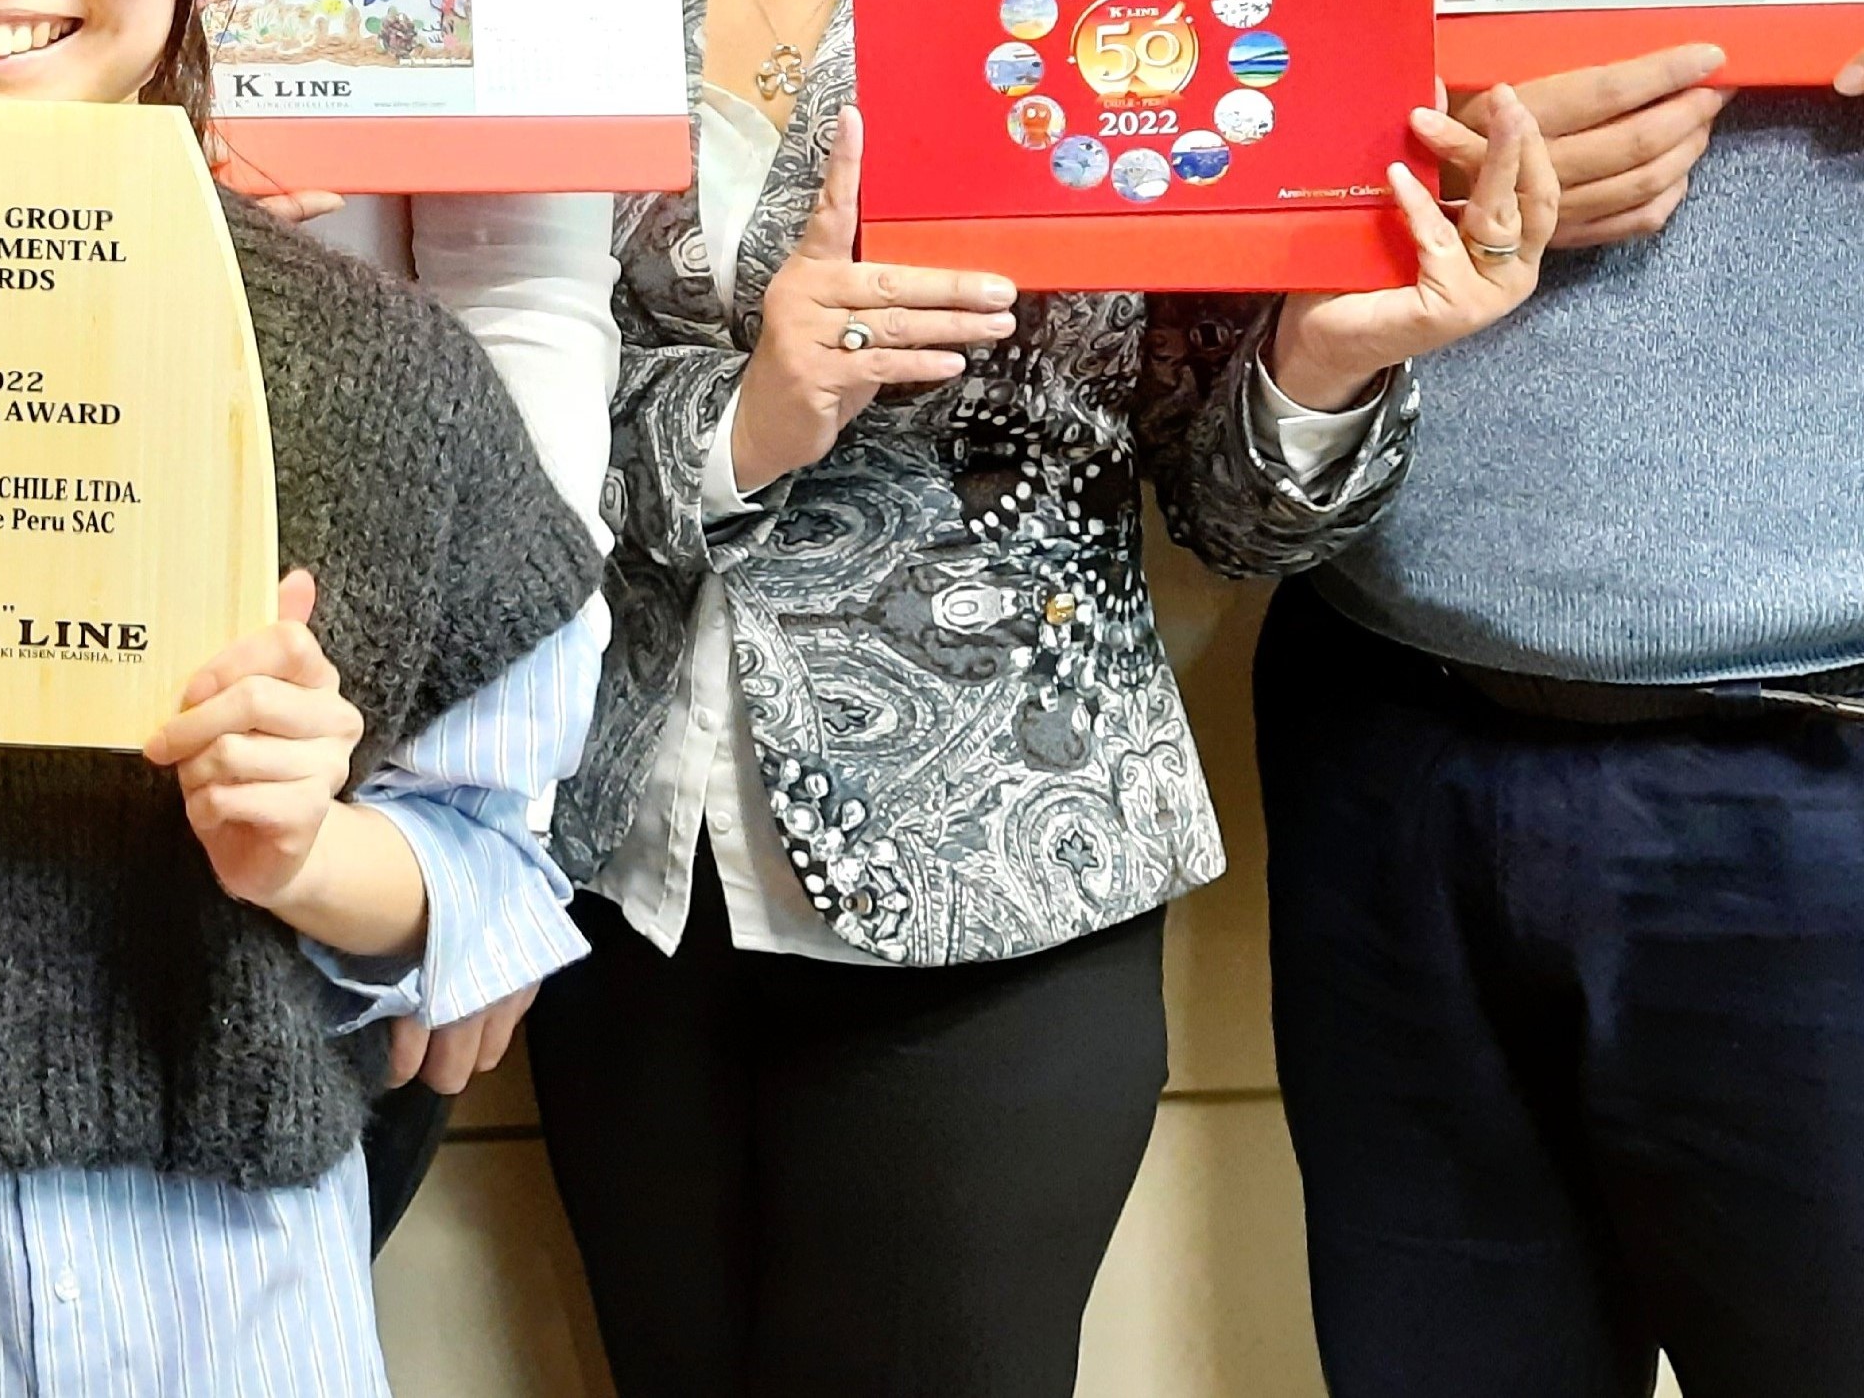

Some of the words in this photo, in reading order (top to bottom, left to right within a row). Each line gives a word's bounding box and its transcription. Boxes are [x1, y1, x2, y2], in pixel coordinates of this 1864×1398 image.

[1127, 6, 1160, 17] LINE
[1095, 16, 1182, 82] 50
[274, 80, 353, 98] LINE
[1097, 109, 1180, 138] 2022
[4, 205, 115, 232] GROUP
[4, 400, 122, 427] AWARD
[74, 478, 142, 505] LTDA.
[11, 508, 66, 534] Peru
[71, 510, 116, 536] SAC
[18, 618, 149, 651] LINE
[18, 647, 56, 660] KISEN
[61, 649, 114, 664] KAISHA,
[118, 651, 146, 665] LTD.
